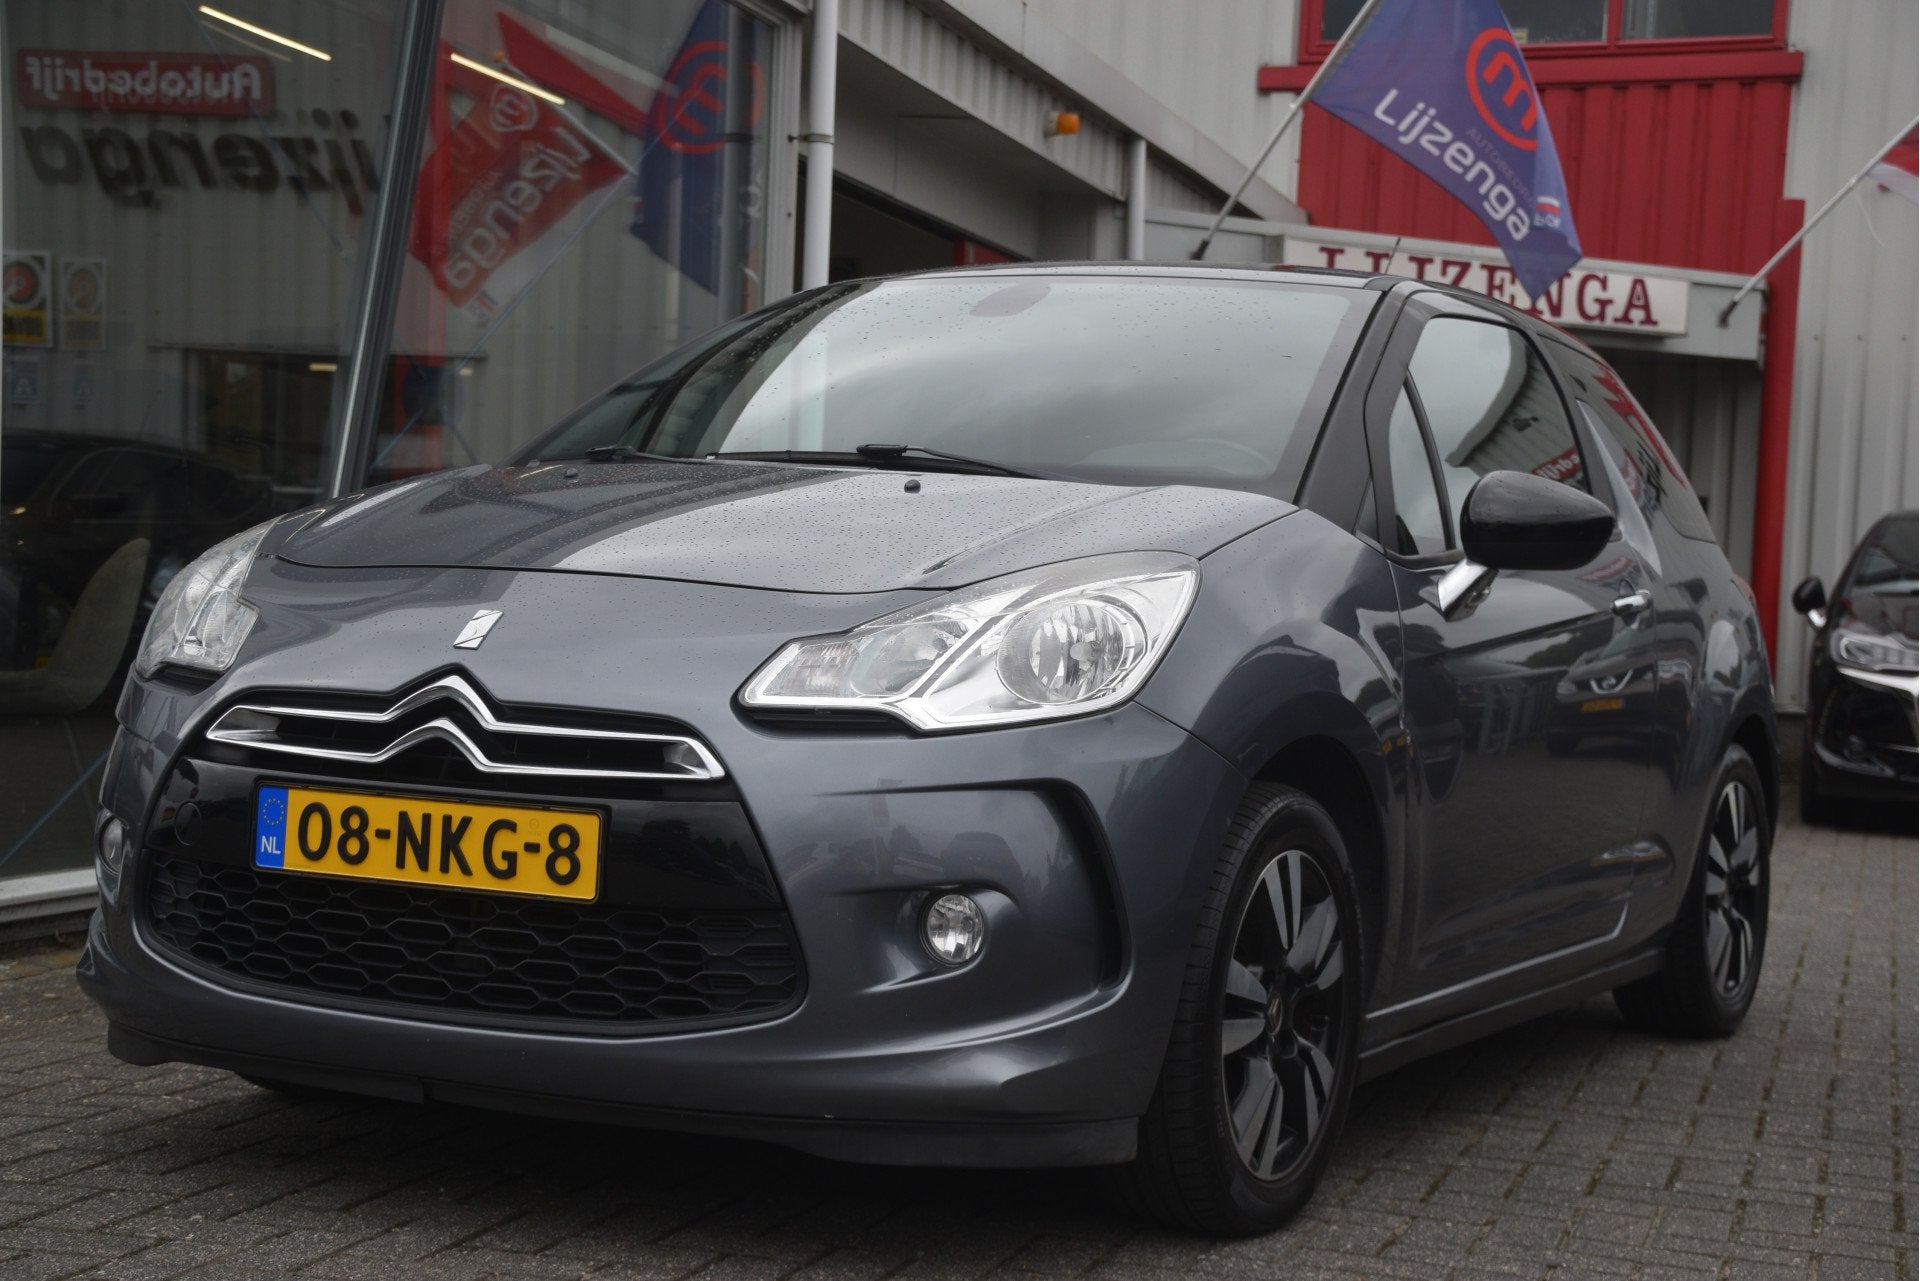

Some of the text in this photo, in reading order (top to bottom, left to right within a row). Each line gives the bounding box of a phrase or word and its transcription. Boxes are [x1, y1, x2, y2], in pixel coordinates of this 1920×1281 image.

[1374, 88, 1531, 242] Lijzenga
[260, 835, 281, 855] NL
[298, 801, 581, 886] 08-NKG-8
